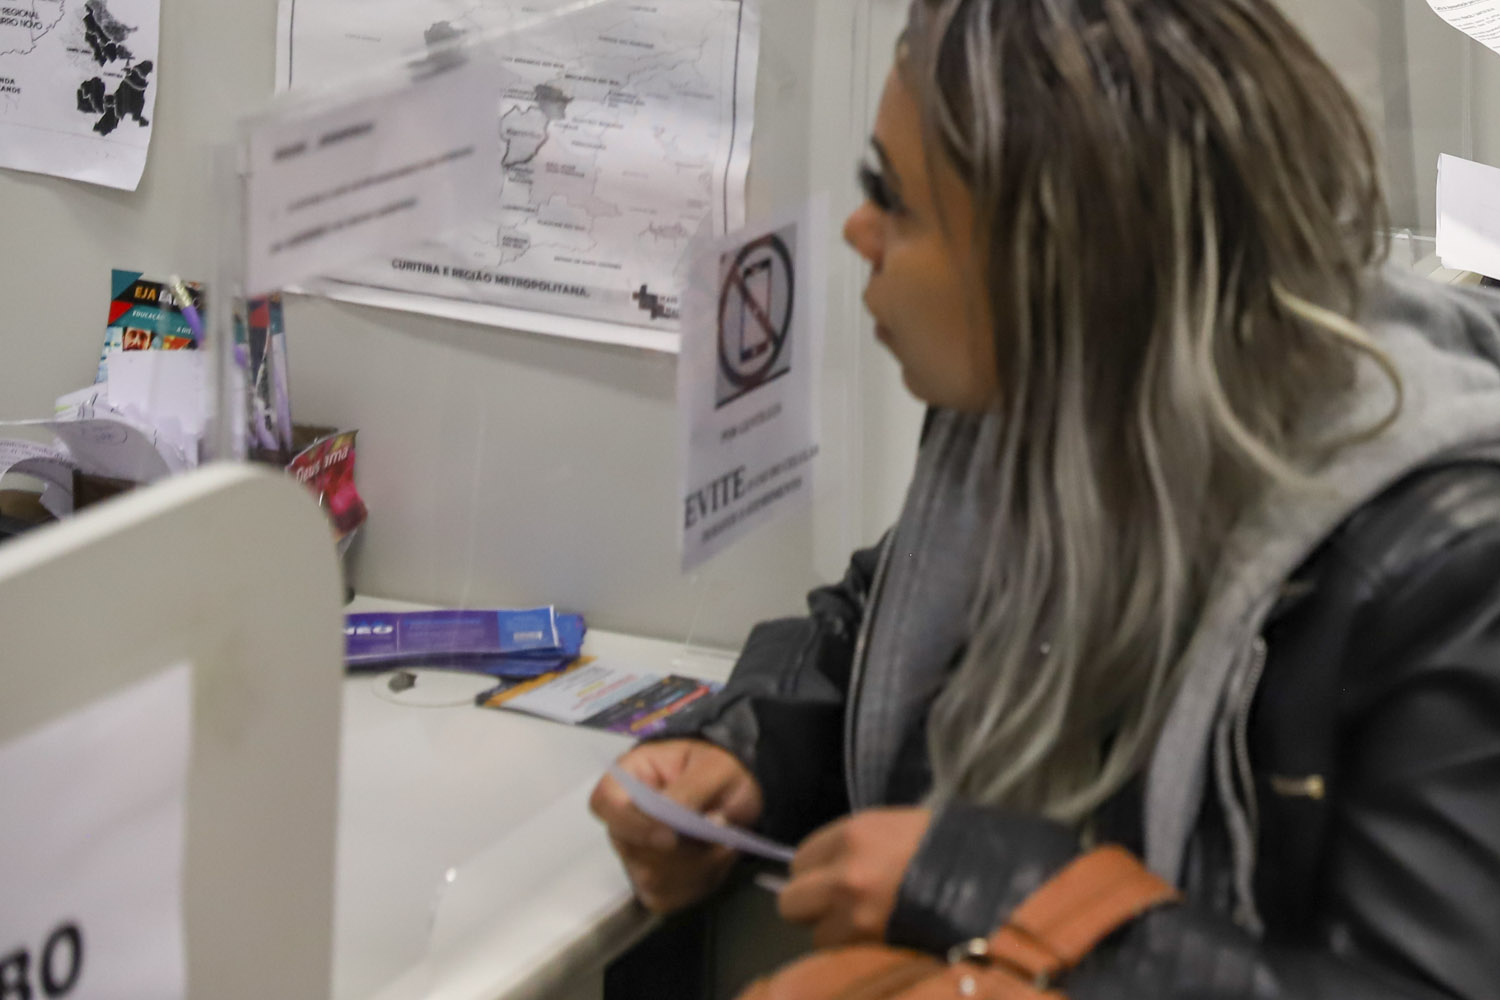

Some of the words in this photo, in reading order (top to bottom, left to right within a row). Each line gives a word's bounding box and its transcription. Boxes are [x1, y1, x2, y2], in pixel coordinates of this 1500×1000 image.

[391, 258, 440, 276] CURITIBA
[451, 266, 492, 285] REGIÃO
[683, 464, 746, 530] EVITE
